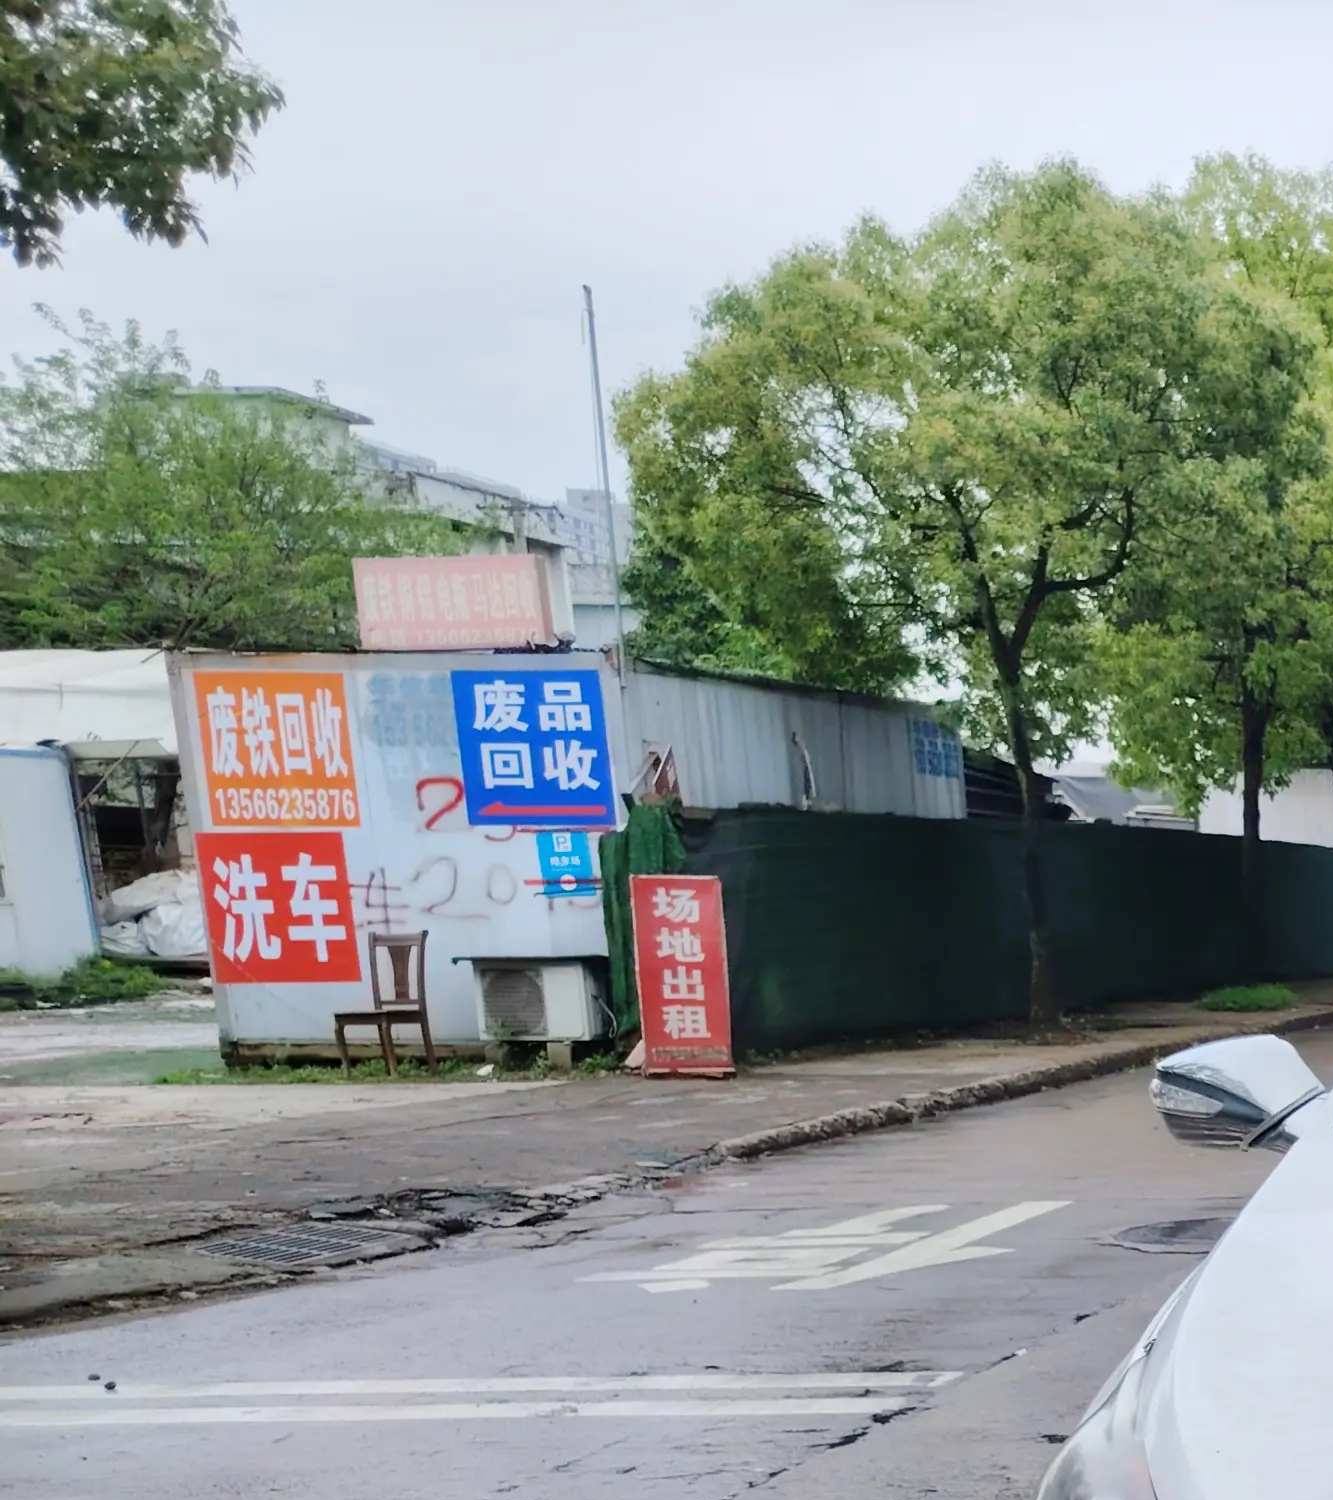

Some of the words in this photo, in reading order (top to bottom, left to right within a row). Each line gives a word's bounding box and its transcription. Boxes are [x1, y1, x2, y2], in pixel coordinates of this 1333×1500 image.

[206, 685, 349, 778] 废铁回收
[472, 679, 593, 732] 废品
[479, 739, 601, 791] 回收
[215, 787, 356, 820] 13566235876
[212, 852, 347, 963] 洗车
[652, 887, 711, 1040] 场地出租
